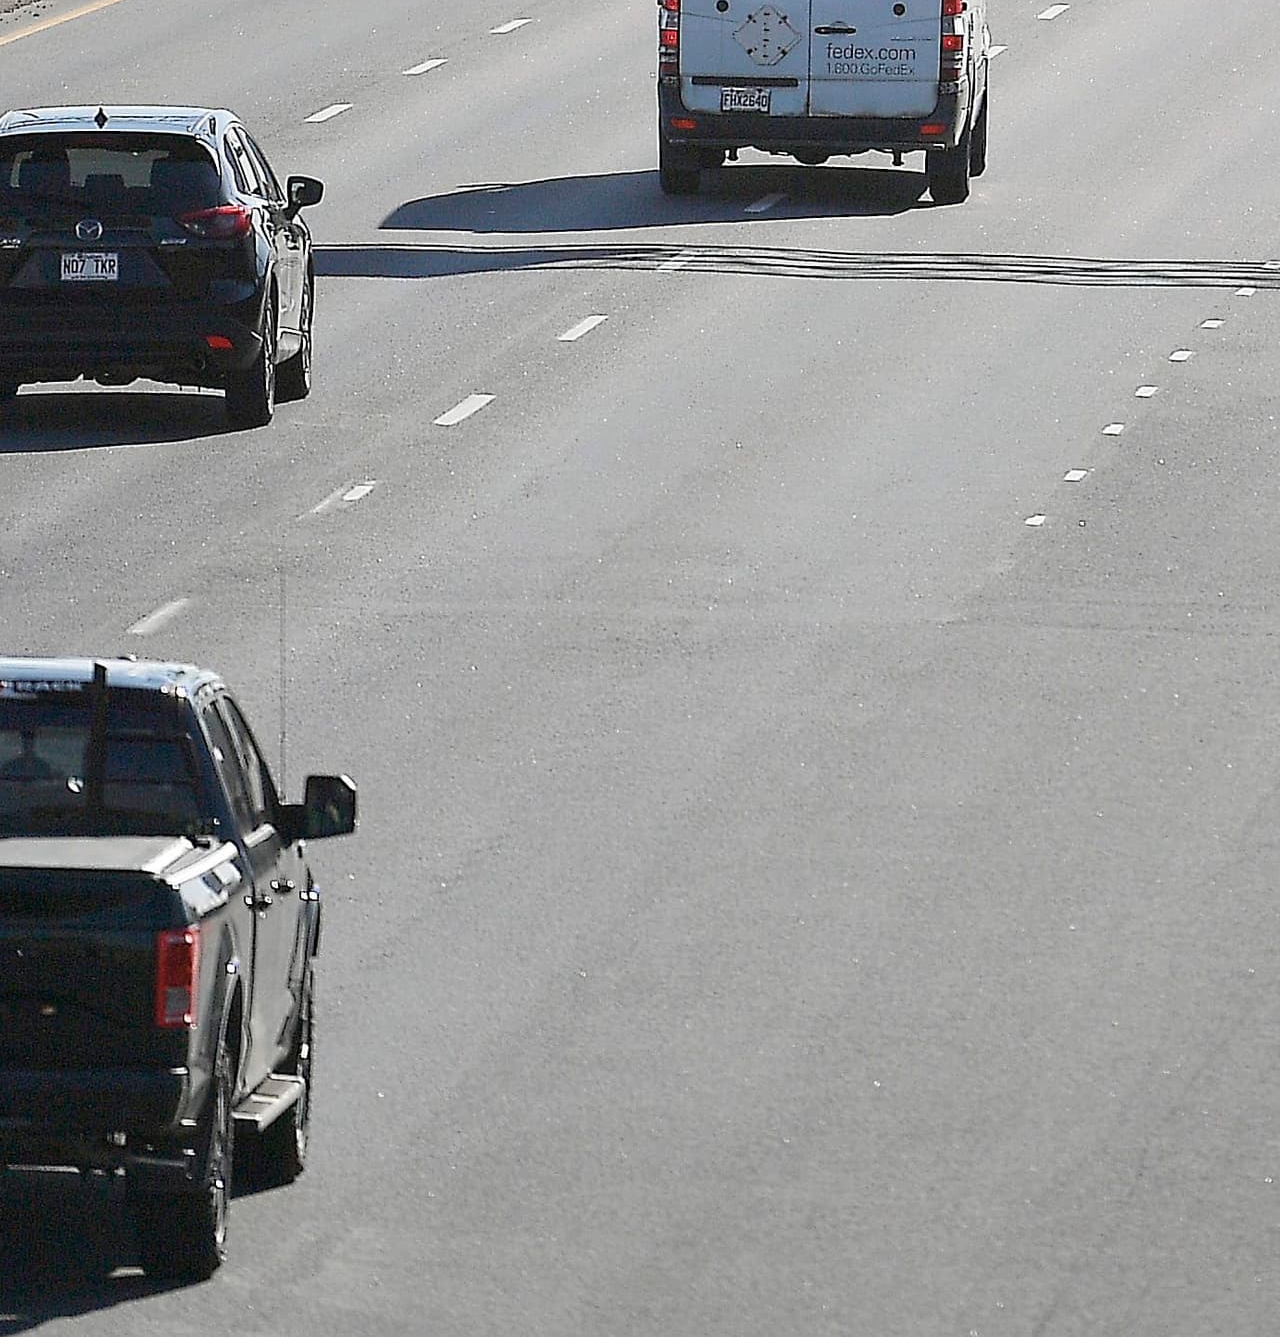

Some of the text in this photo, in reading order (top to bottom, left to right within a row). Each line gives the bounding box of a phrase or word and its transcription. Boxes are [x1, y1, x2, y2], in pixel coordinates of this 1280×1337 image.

[826, 42, 917, 61] fedex.com
[62, 259, 118, 275] N07 TKR
